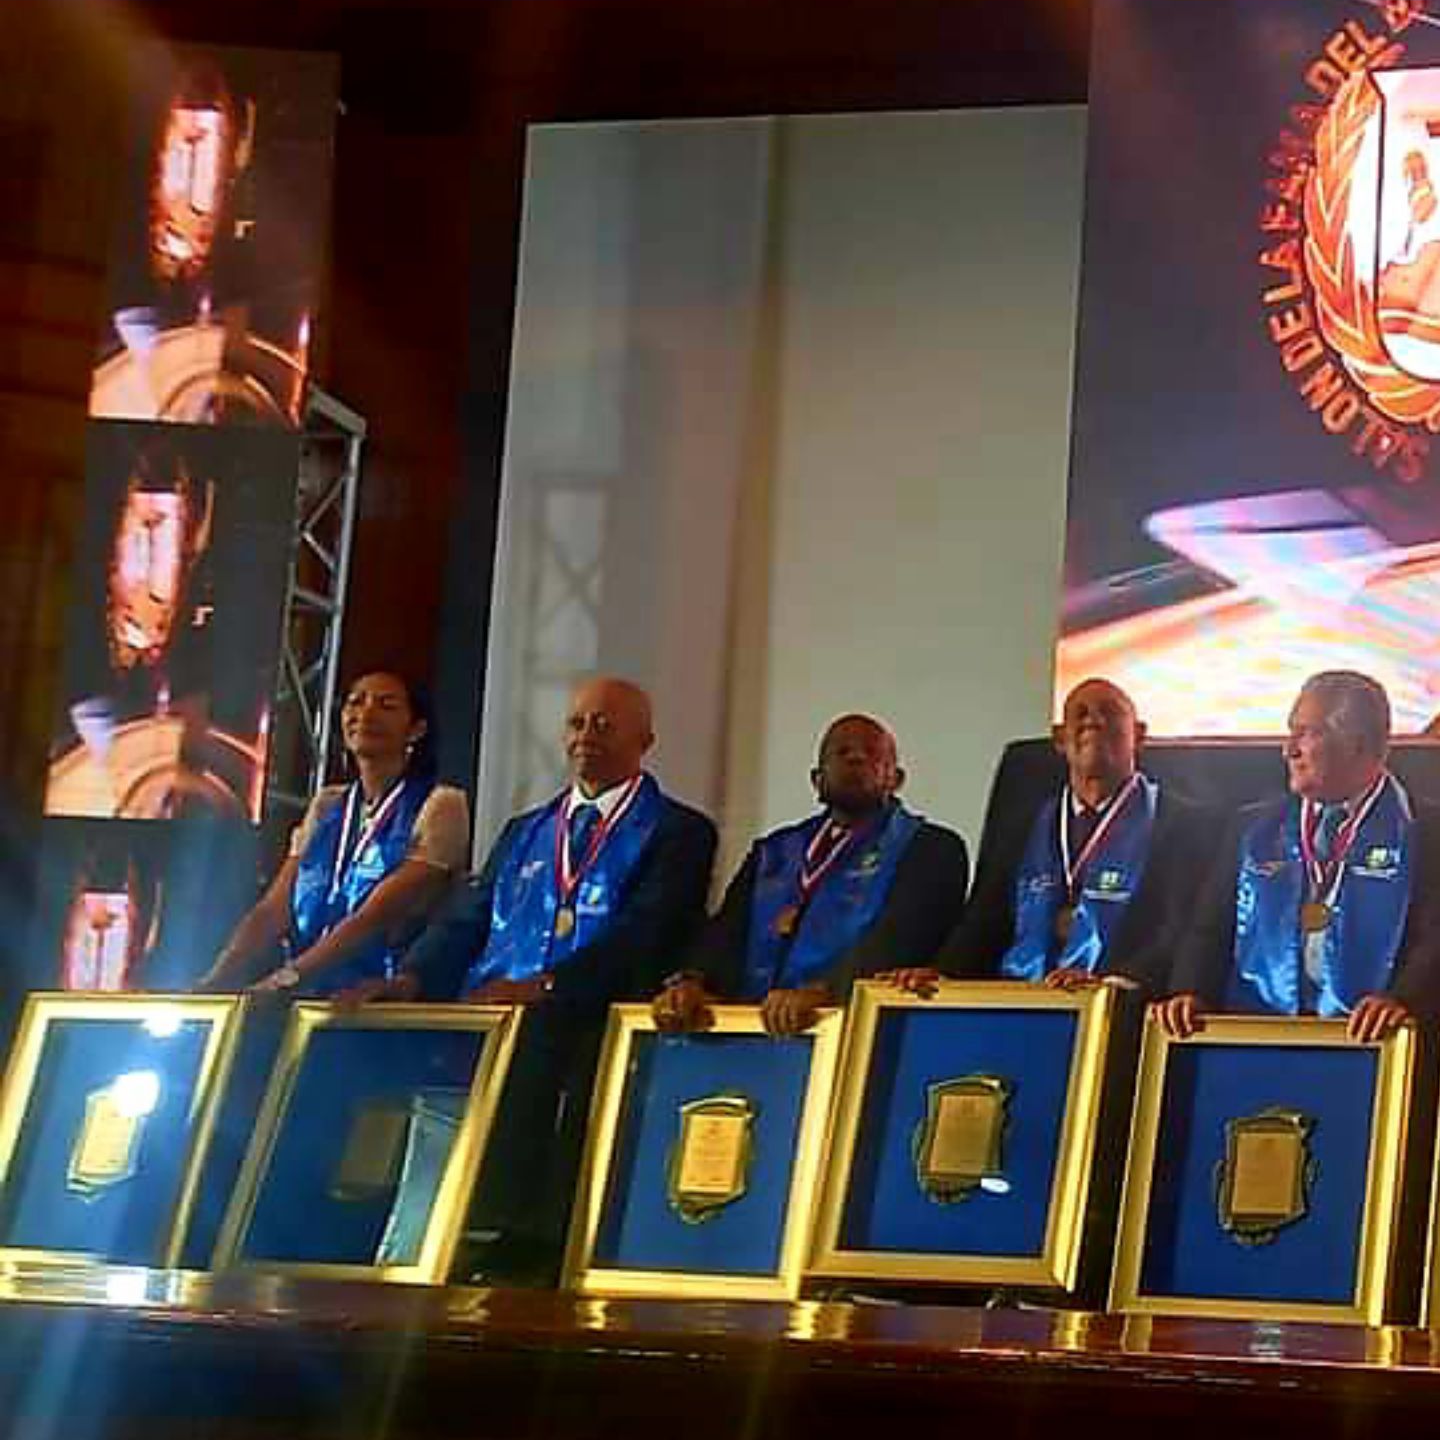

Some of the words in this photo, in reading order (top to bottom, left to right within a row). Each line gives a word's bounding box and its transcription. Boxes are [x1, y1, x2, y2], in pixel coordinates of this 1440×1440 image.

[1304, 19, 1388, 96] DEL
[1260, 237, 1304, 302] LA
[1269, 303, 1325, 372] DE
